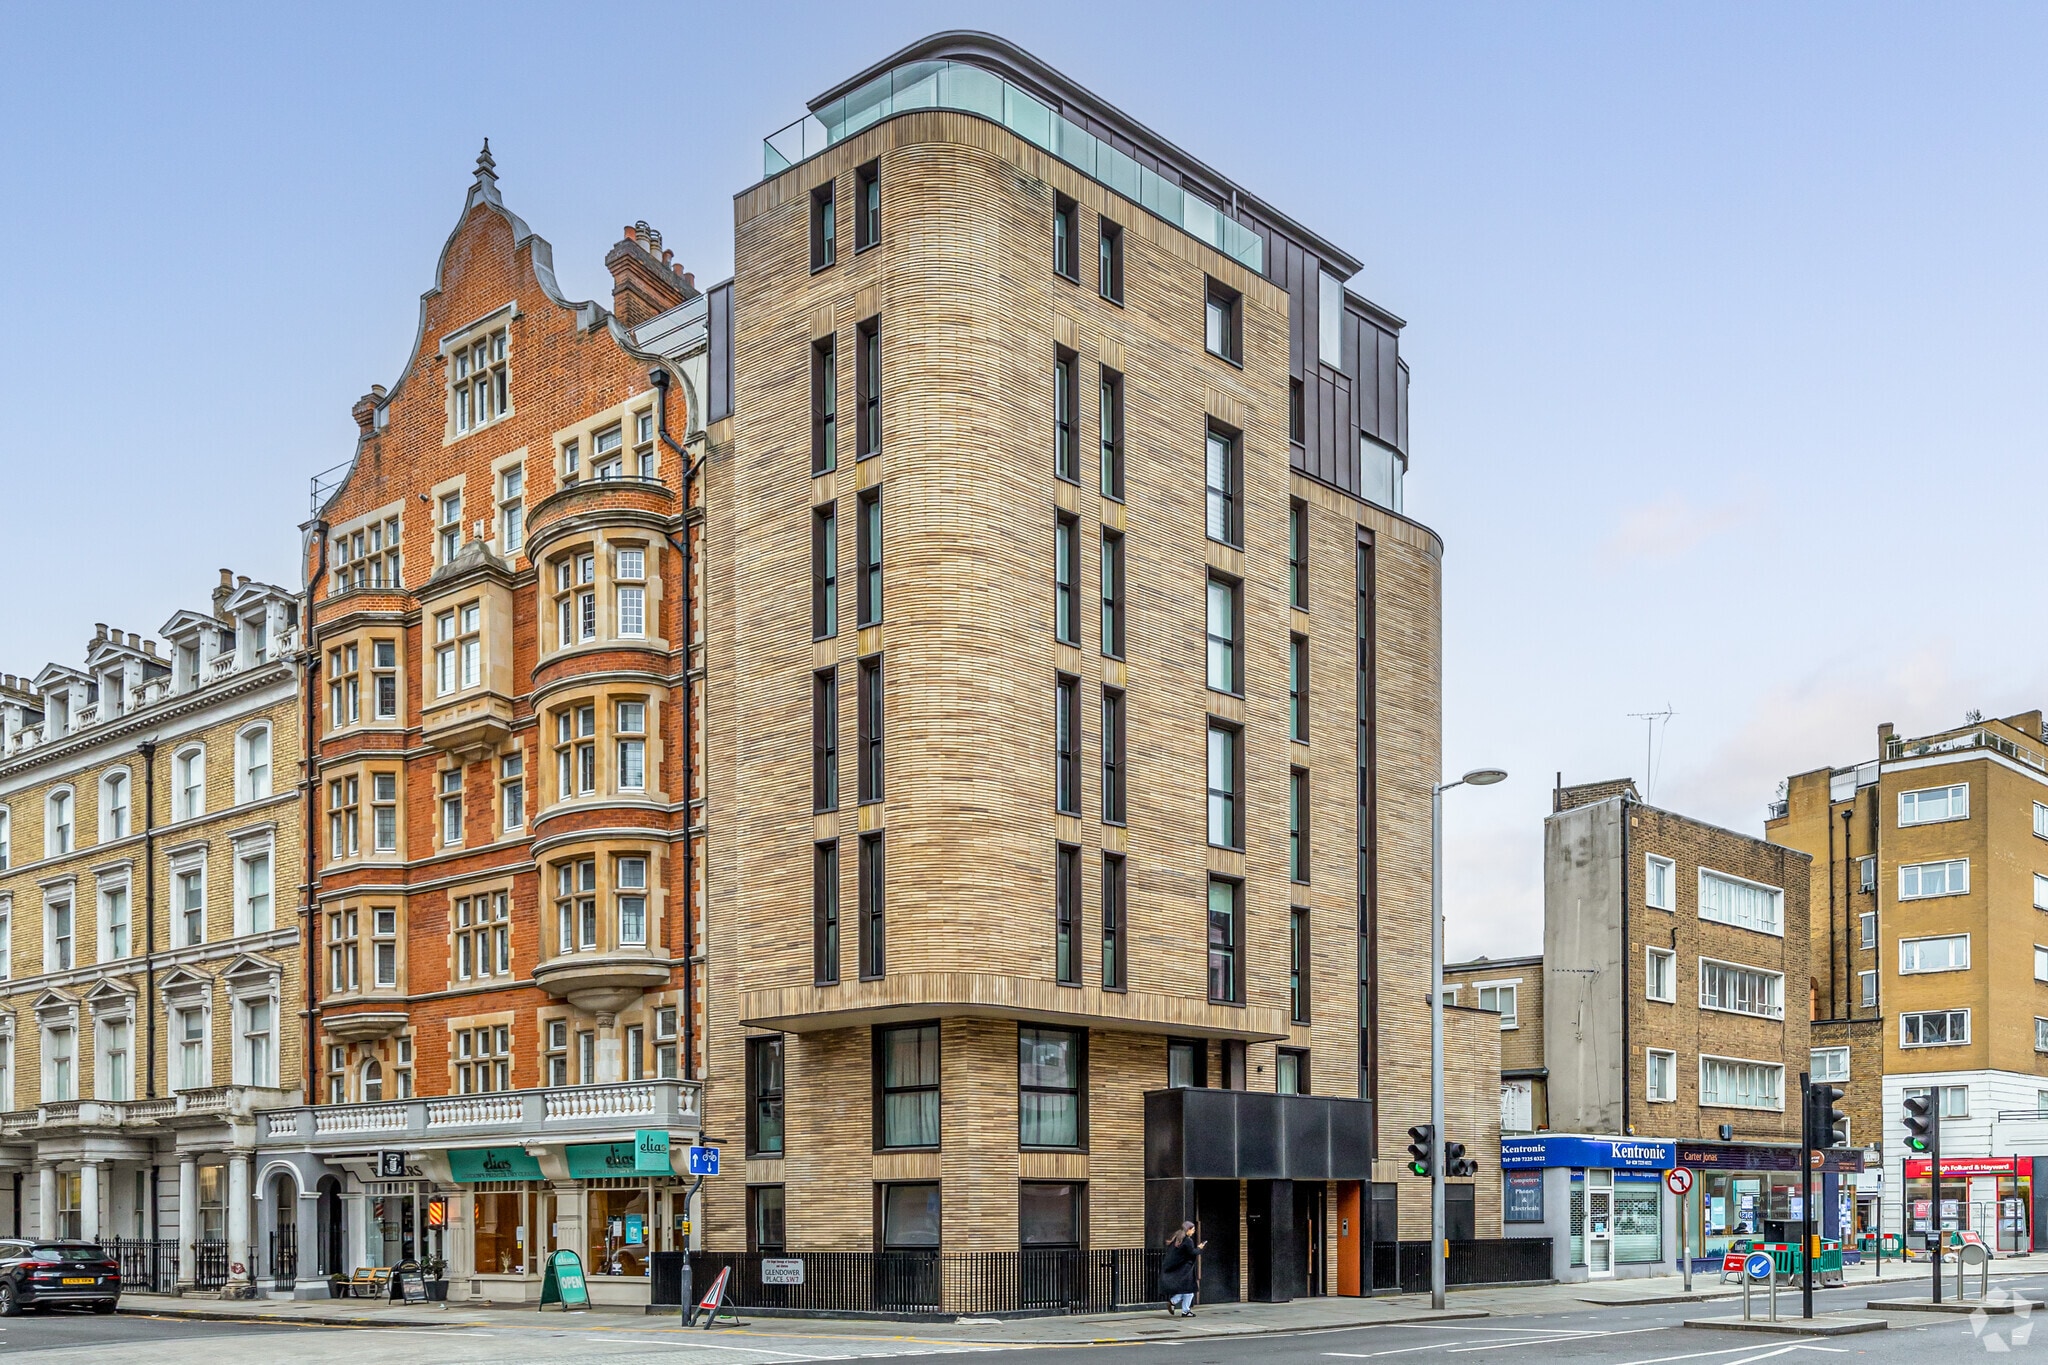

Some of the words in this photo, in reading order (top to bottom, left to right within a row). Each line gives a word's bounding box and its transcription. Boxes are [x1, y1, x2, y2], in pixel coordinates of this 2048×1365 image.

[640, 1134, 666, 1152] elias
[1501, 1144, 1546, 1154] Kentronic
[1611, 1142, 1666, 1160] Kentronic
[1684, 1152, 1702, 1161] Carter
[1703, 1152, 1718, 1163] Jonas
[483, 1149, 511, 1169] elias
[1981, 1163, 2010, 1172] Hayward
[561, 1276, 583, 1289] OPEN
